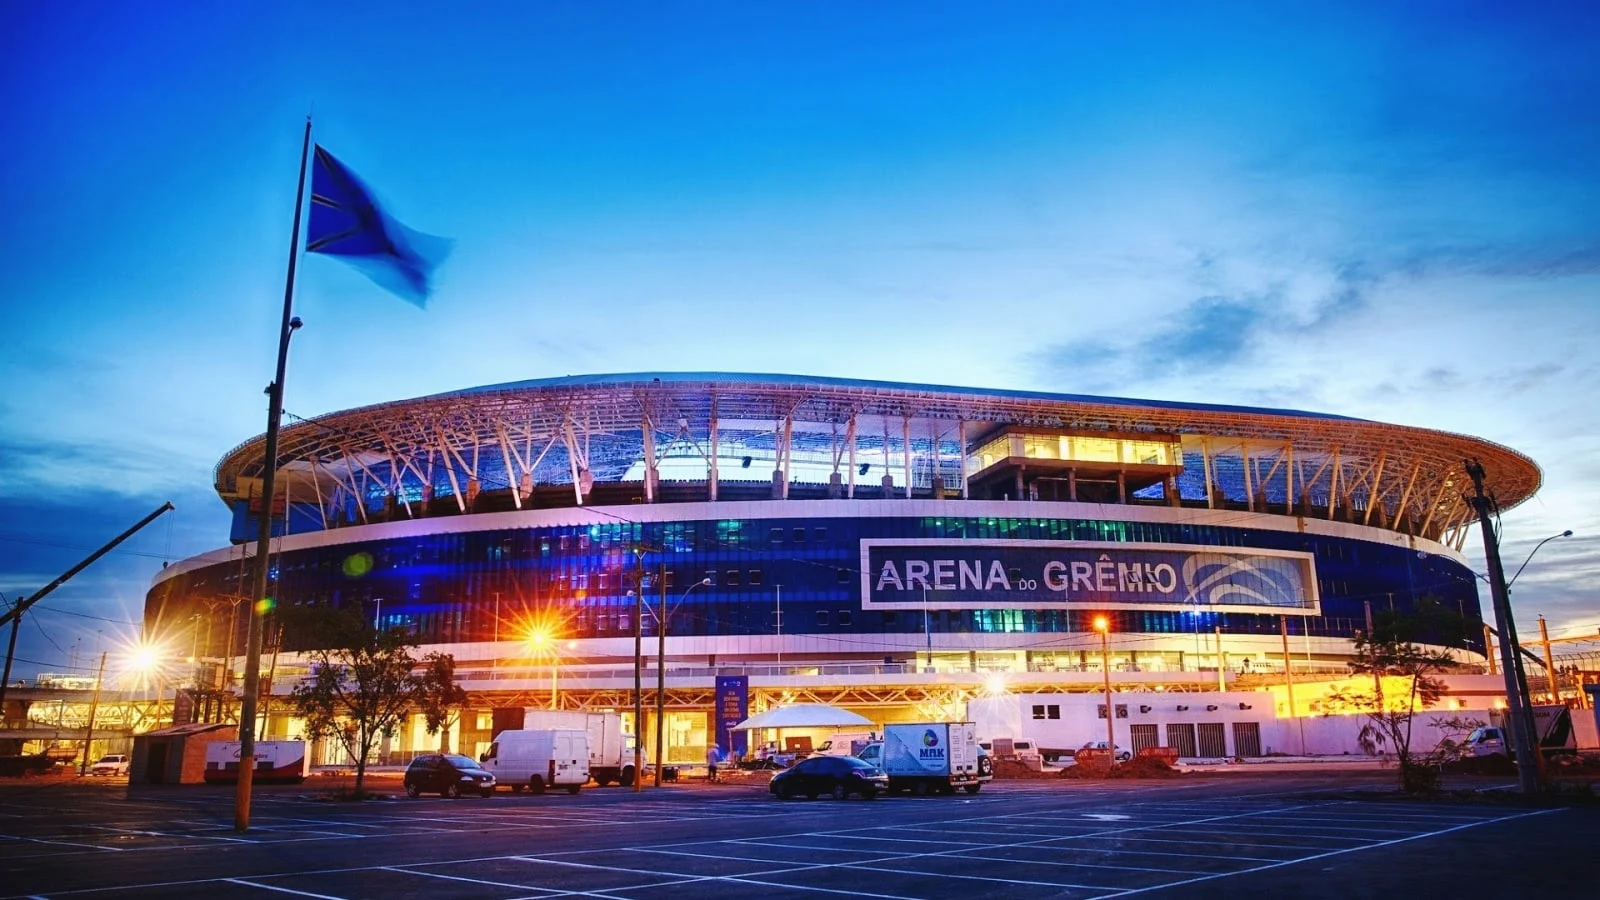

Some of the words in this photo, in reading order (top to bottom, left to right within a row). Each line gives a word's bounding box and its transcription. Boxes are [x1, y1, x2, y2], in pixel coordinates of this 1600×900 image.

[876, 559, 1012, 591] ARENA
[1018, 578, 1038, 591] DO
[1043, 553, 1177, 593] GRÊMIO
